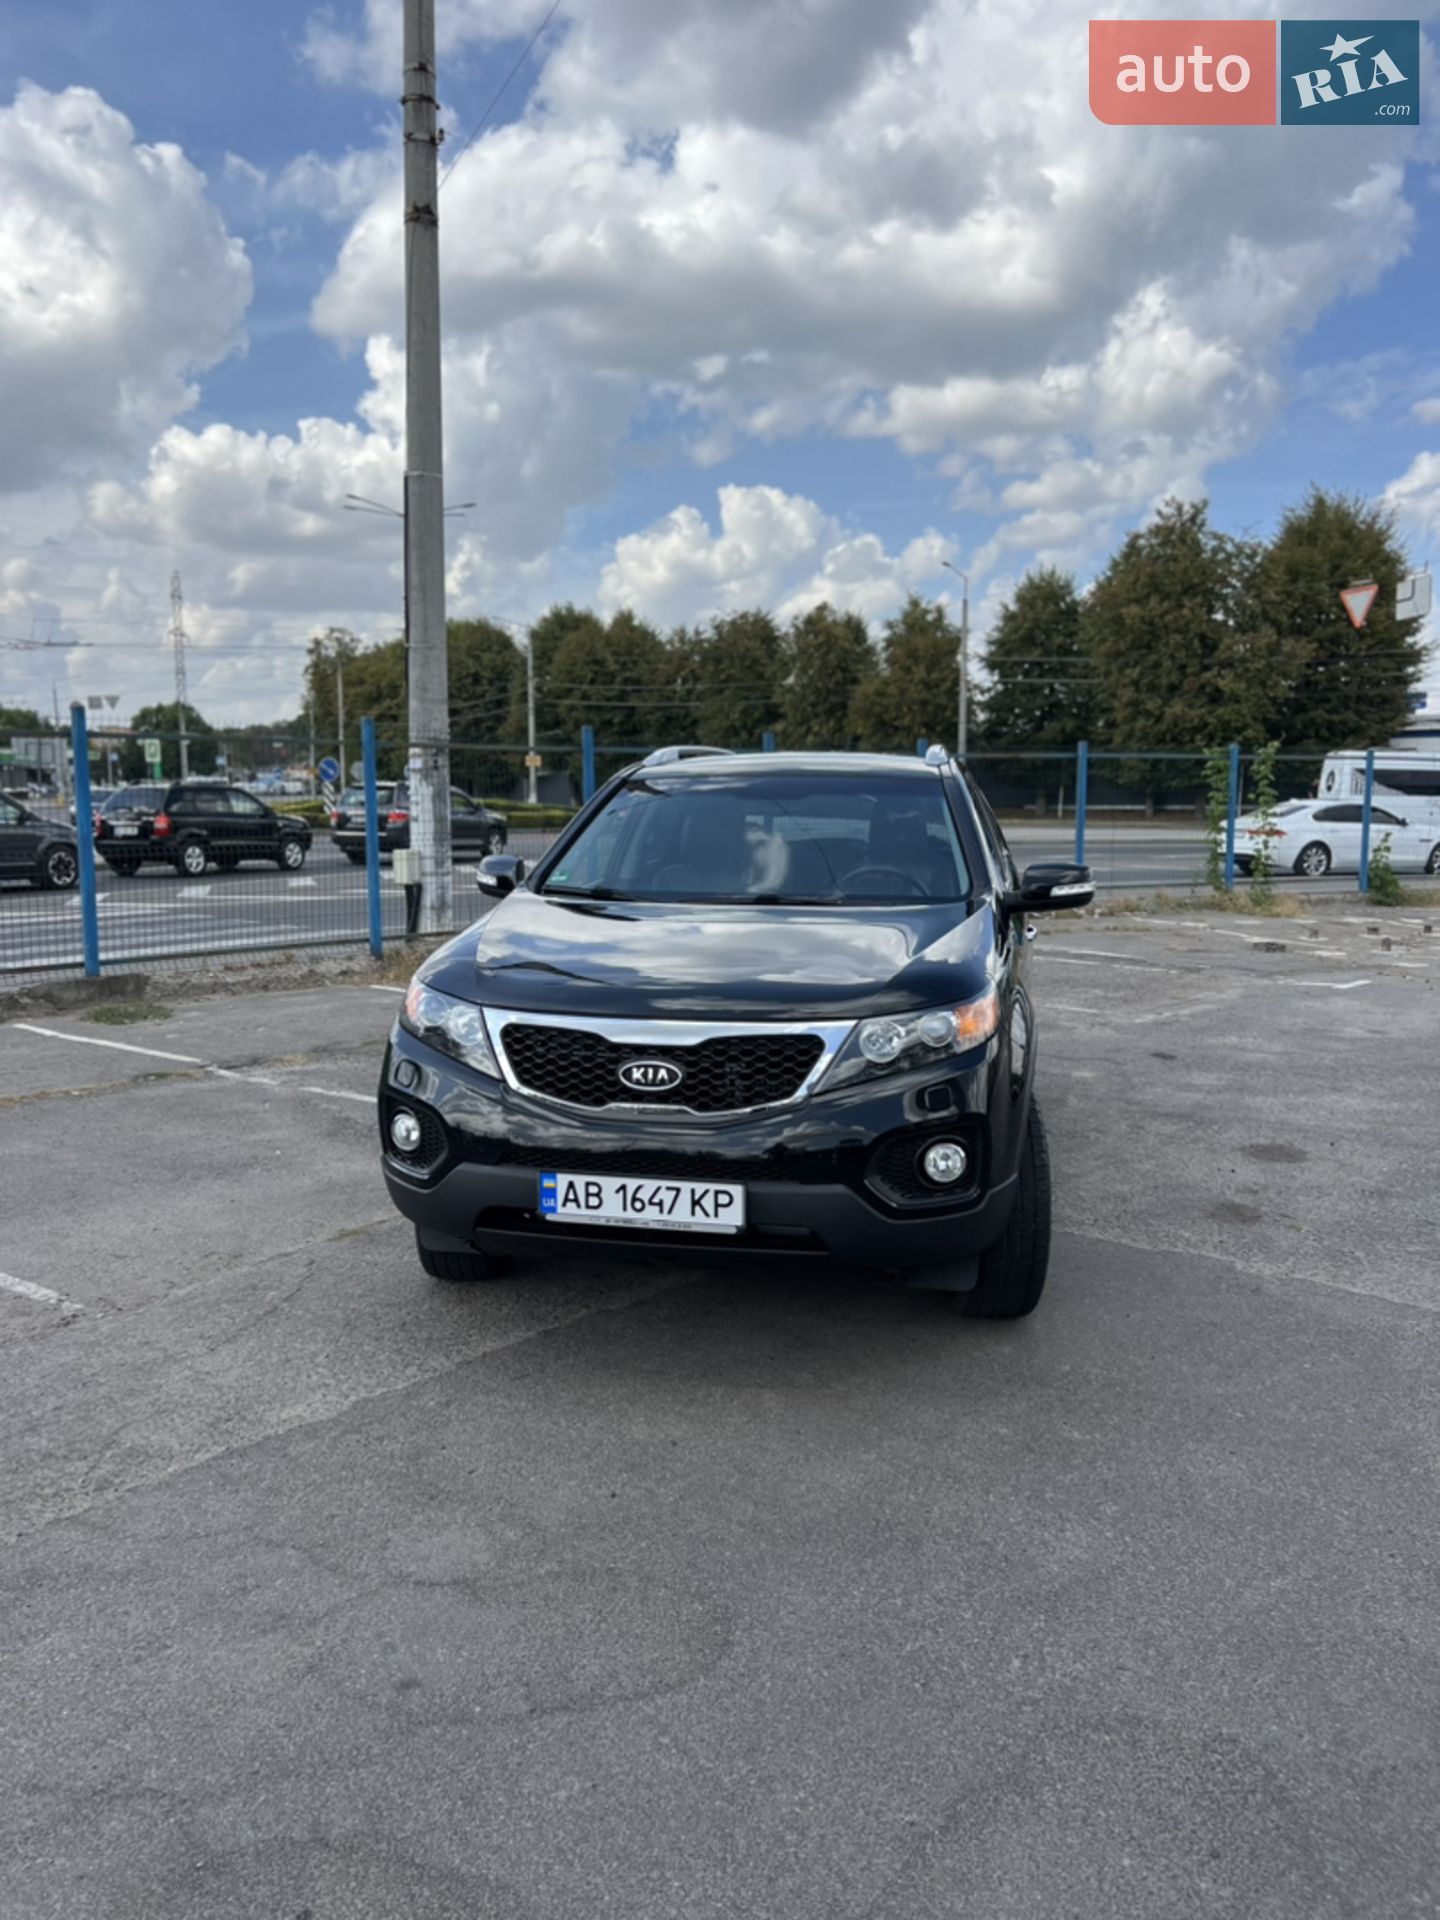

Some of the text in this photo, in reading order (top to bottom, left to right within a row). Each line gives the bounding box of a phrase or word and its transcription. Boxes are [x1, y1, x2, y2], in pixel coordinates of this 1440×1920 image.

[631, 1067, 669, 1084] KIA
[561, 1180, 735, 1218] AB 1647 KP
